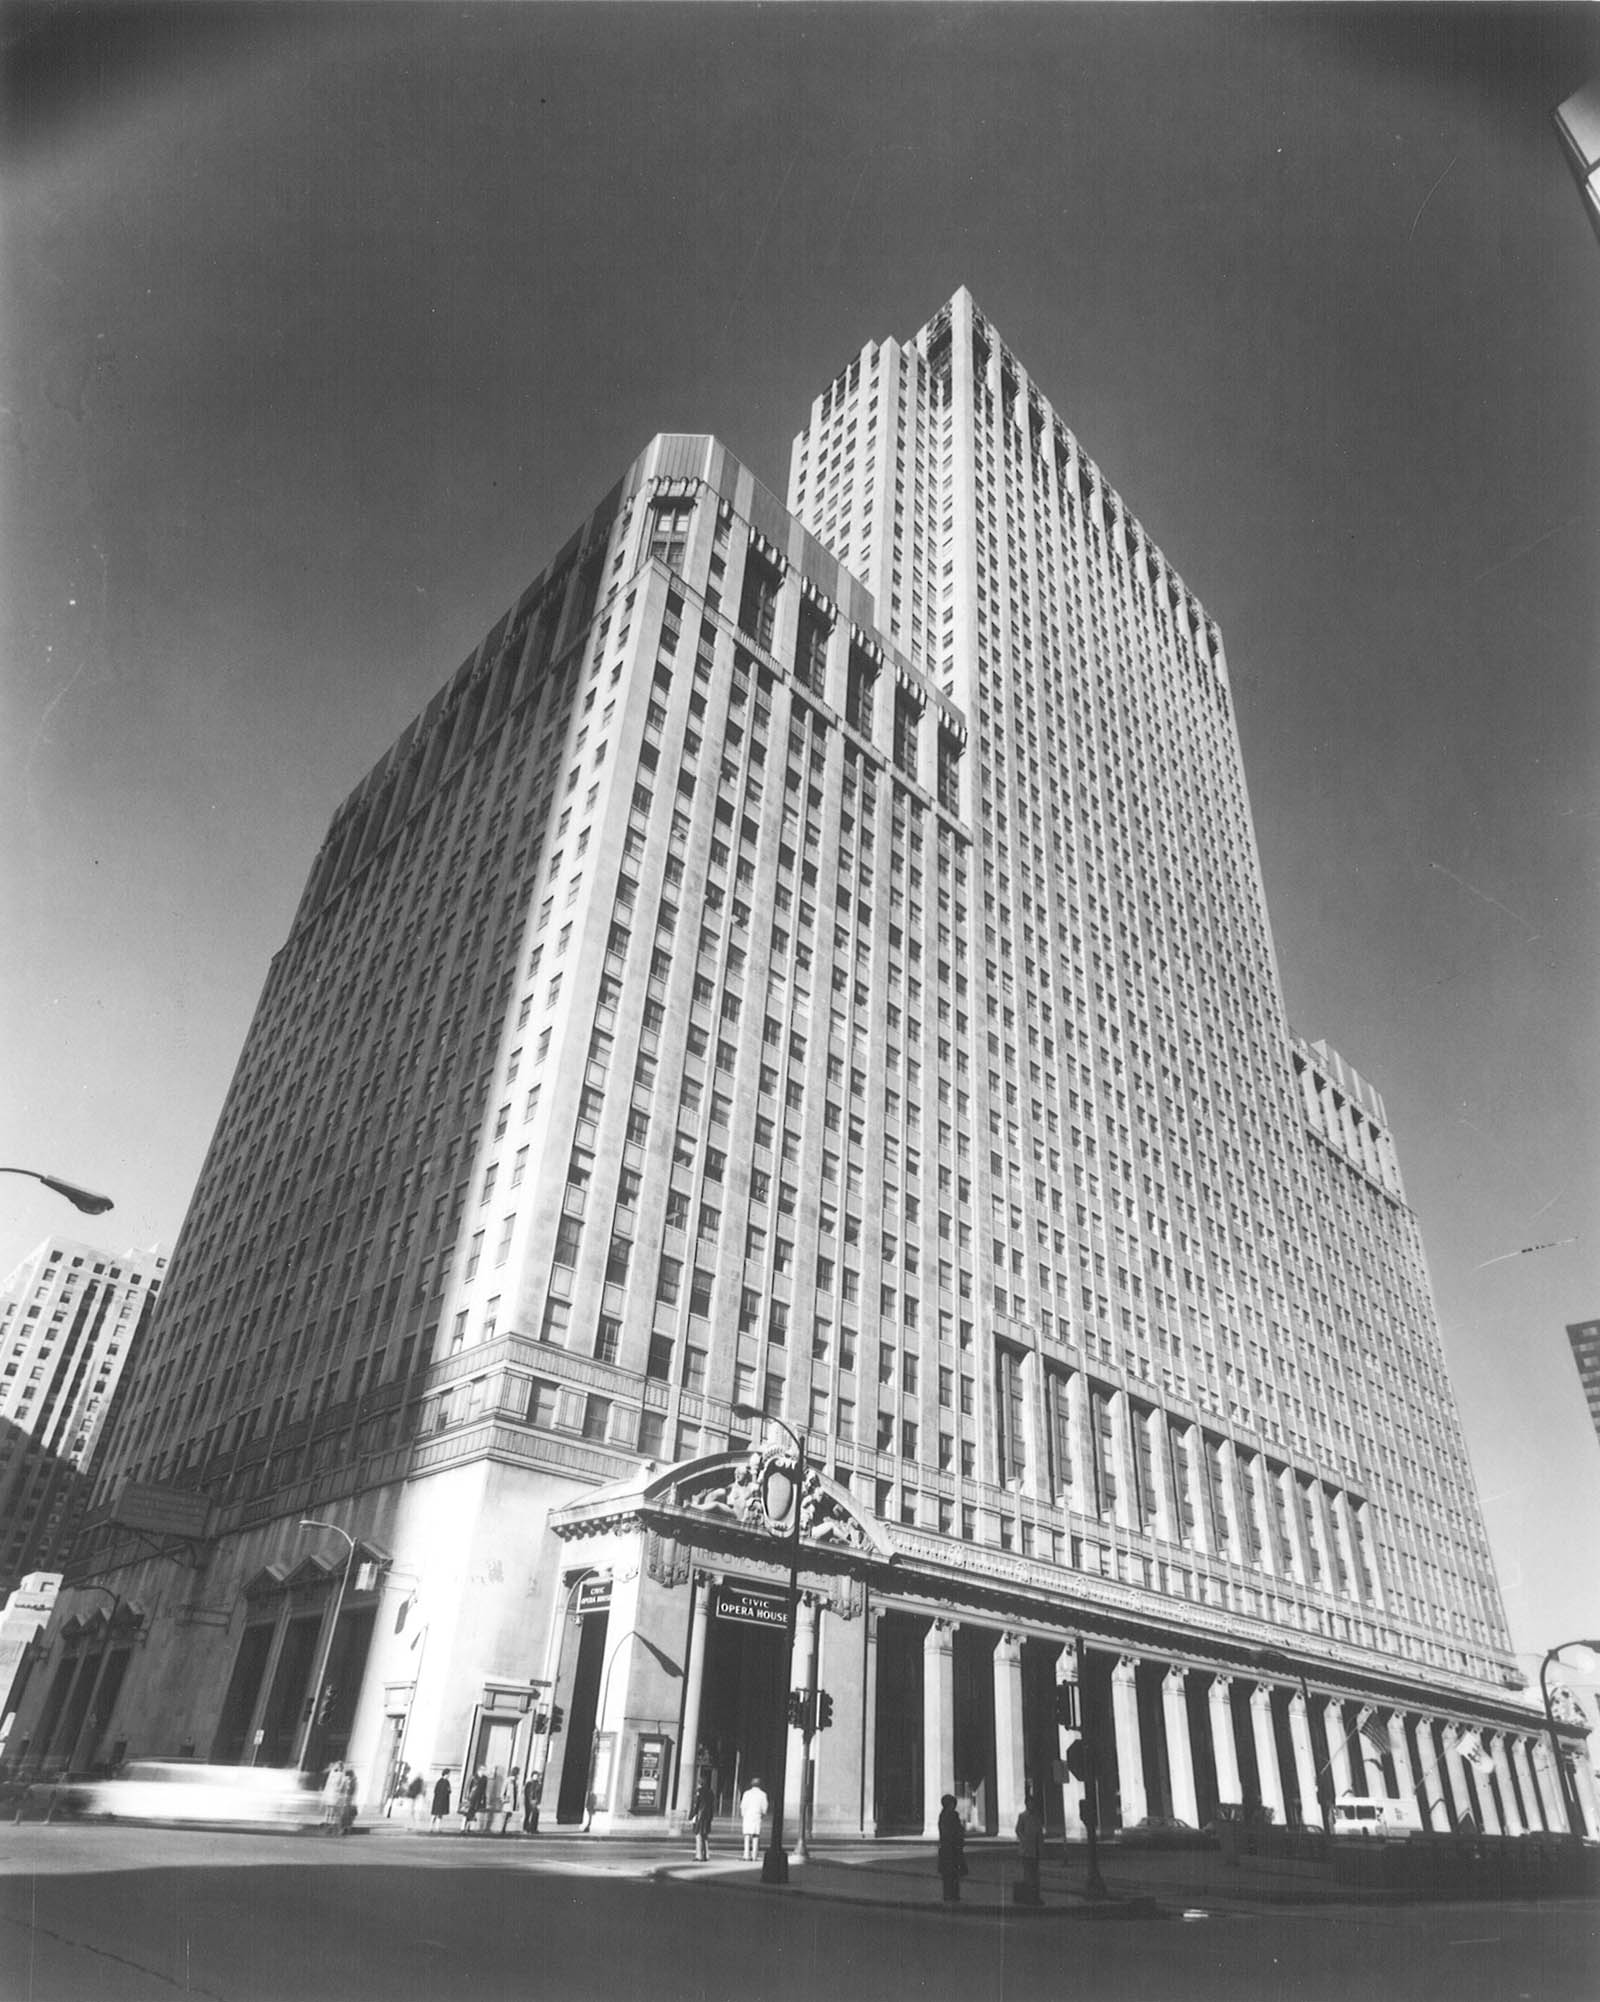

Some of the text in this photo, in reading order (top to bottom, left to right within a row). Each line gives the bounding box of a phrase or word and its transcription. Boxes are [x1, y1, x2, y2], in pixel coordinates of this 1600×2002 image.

[742, 1597, 770, 1609] CIVIC
[720, 1602, 789, 1623] OPERA HOUSE
